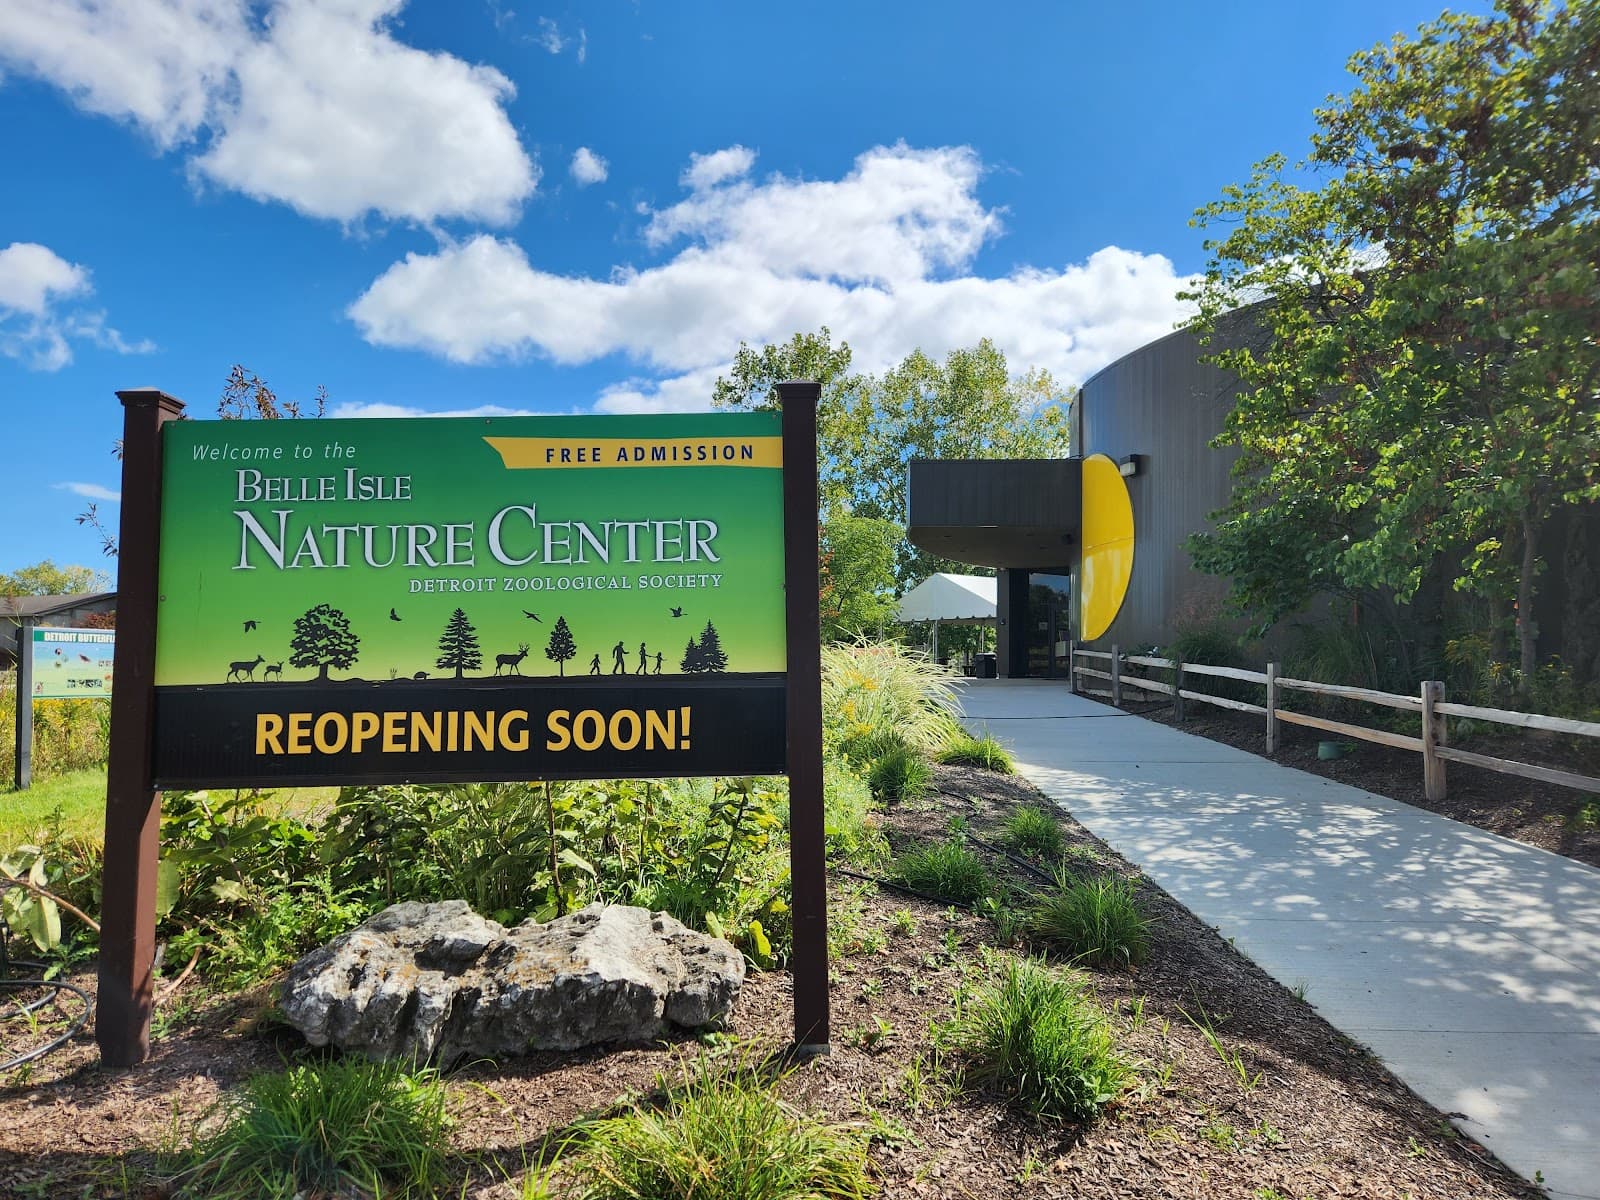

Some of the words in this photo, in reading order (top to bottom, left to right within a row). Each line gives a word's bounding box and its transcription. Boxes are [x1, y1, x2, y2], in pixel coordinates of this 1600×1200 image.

[192, 443, 283, 460] Welcome
[294, 444, 313, 459] to
[324, 442, 356, 458] the
[546, 447, 601, 463] FREE
[616, 445, 754, 462] ADMISSION
[234, 468, 336, 502] BELLE
[343, 467, 412, 501] ISLE
[232, 509, 475, 570] NATURE
[487, 502, 721, 566] CENTER
[409, 578, 496, 593] DETROIT
[503, 575, 631, 592] ZOOLOGICAL
[638, 574, 723, 590] SOCIETY
[44, 632, 77, 642] DETROIT
[255, 710, 530, 755] REOPENING
[546, 706, 692, 752] SOON!
